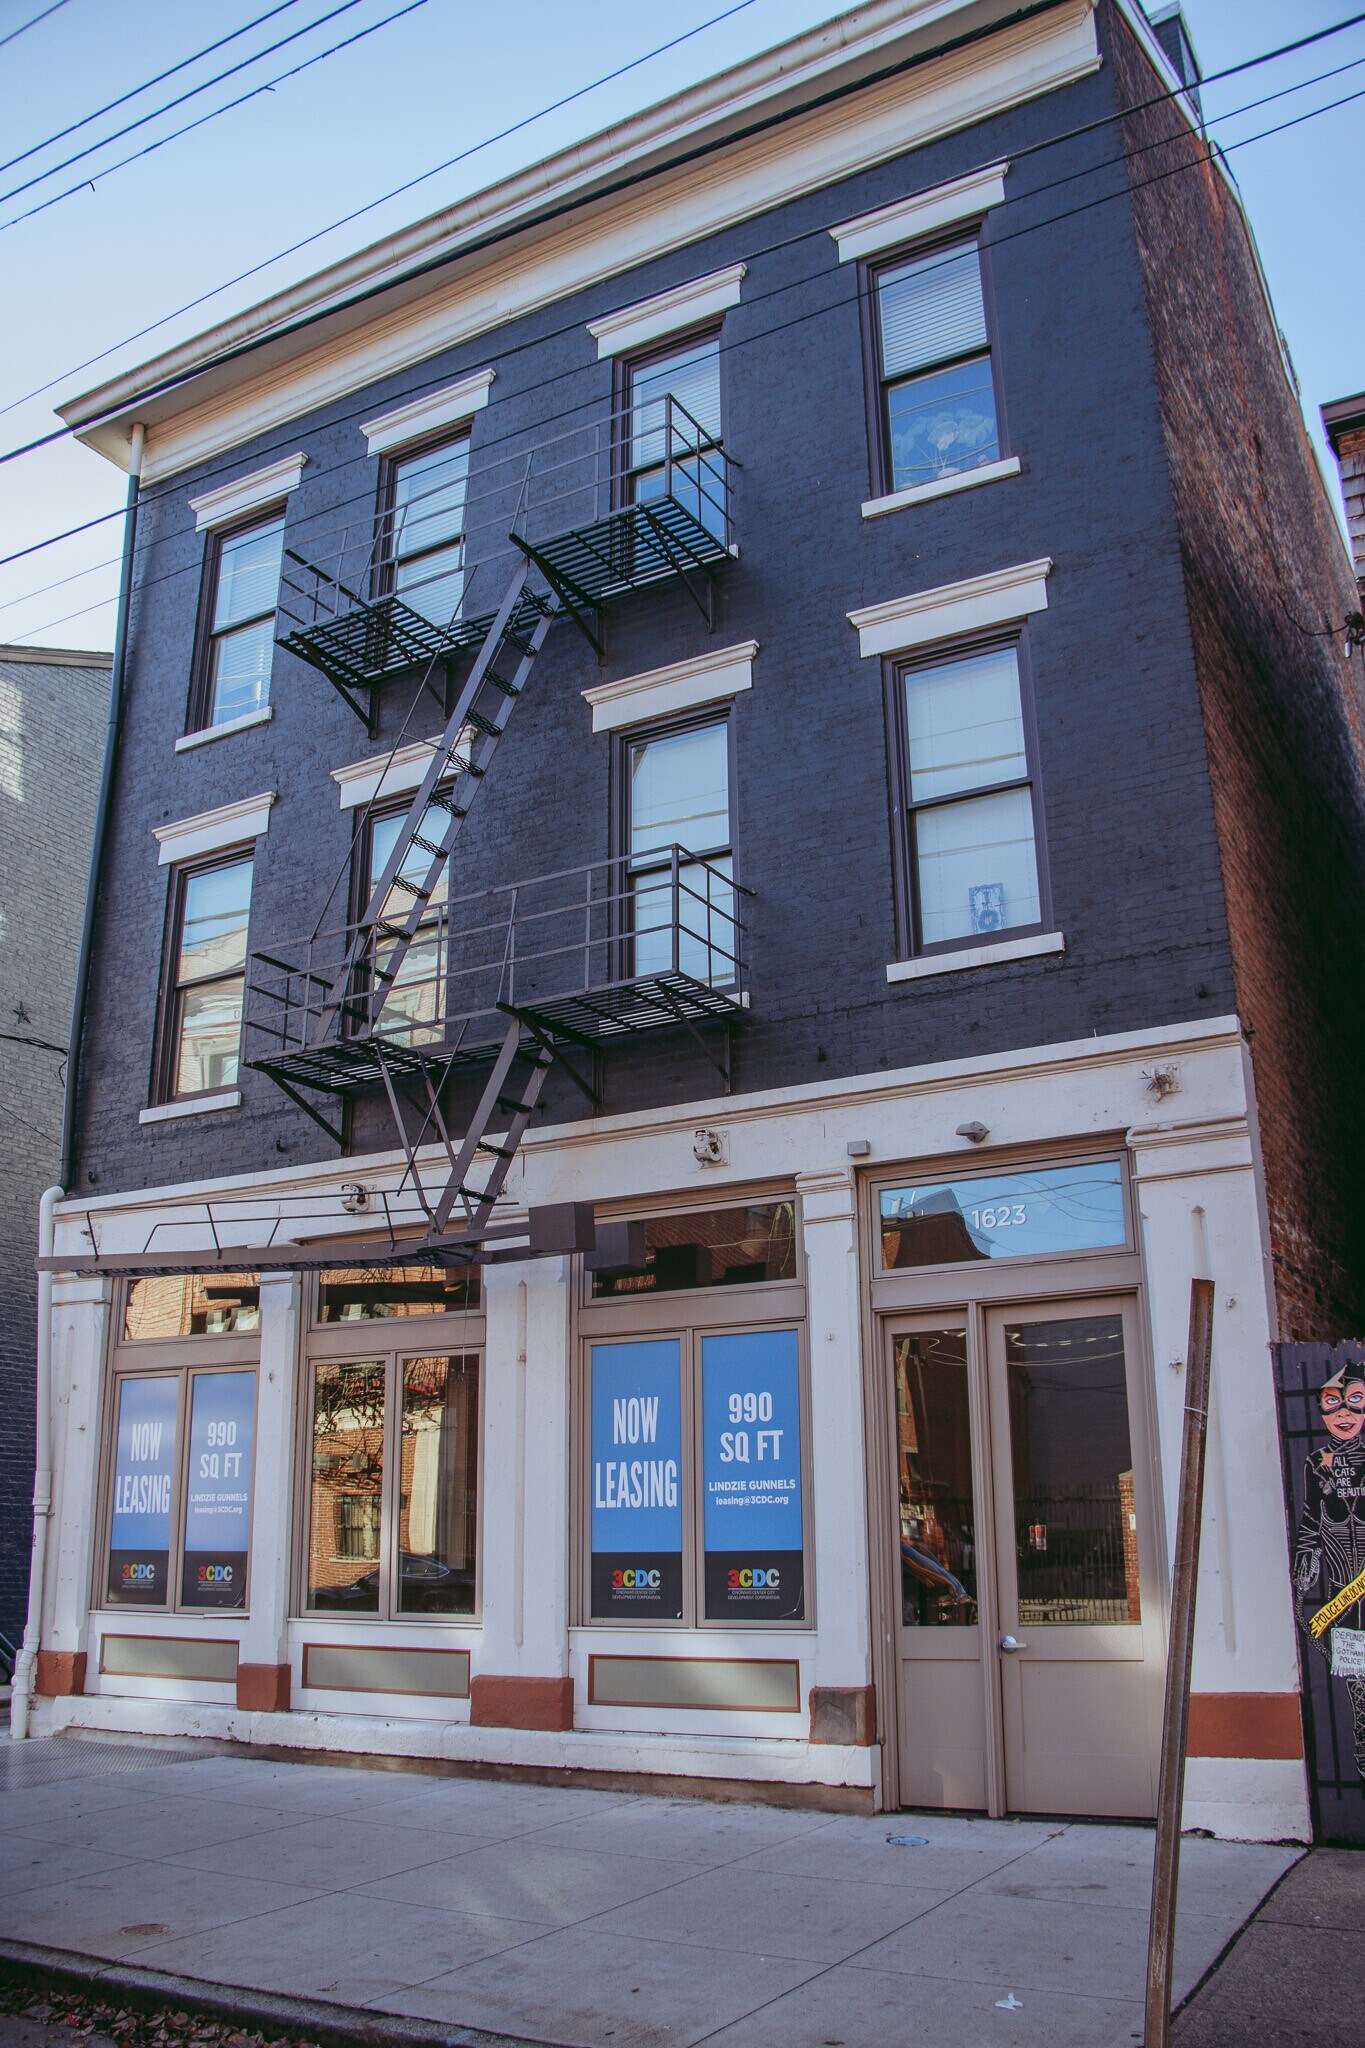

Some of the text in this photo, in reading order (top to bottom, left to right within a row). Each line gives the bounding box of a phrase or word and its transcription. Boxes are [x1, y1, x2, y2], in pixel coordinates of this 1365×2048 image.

[971, 1204, 1027, 1230] 1623
[728, 1392, 773, 1423] 990
[613, 1397, 658, 1444] NOW
[130, 1423, 163, 1461] NOW
[207, 1421, 237, 1446] 990
[720, 1430, 783, 1463] SQ FT
[200, 1452, 242, 1479] SQ FT
[1333, 1456, 1348, 1467] ALL
[1335, 1467, 1356, 1477] CATS
[595, 1460, 677, 1508] LEASING
[708, 1479, 796, 1491] LINDZIE GUNNELS
[1336, 1477, 1352, 1487] ARE
[116, 1475, 171, 1513] LEASING
[715, 1495, 789, 1506] leasing@3CDC.org
[122, 1563, 155, 1579] 3CDC
[198, 1565, 233, 1581] 3CDC
[612, 1569, 661, 1587] 3CDC
[728, 1568, 780, 1587] 3CDC
[1314, 1600, 1342, 1628] POLICE
[1338, 1590, 1353, 1607] LINE
[1334, 1630, 1364, 1642] DEFUND
[1341, 1640, 1355, 1650] THE
[1336, 1646, 1363, 1659] GOTHAM
[1340, 1656, 1363, 1666] POLICE
